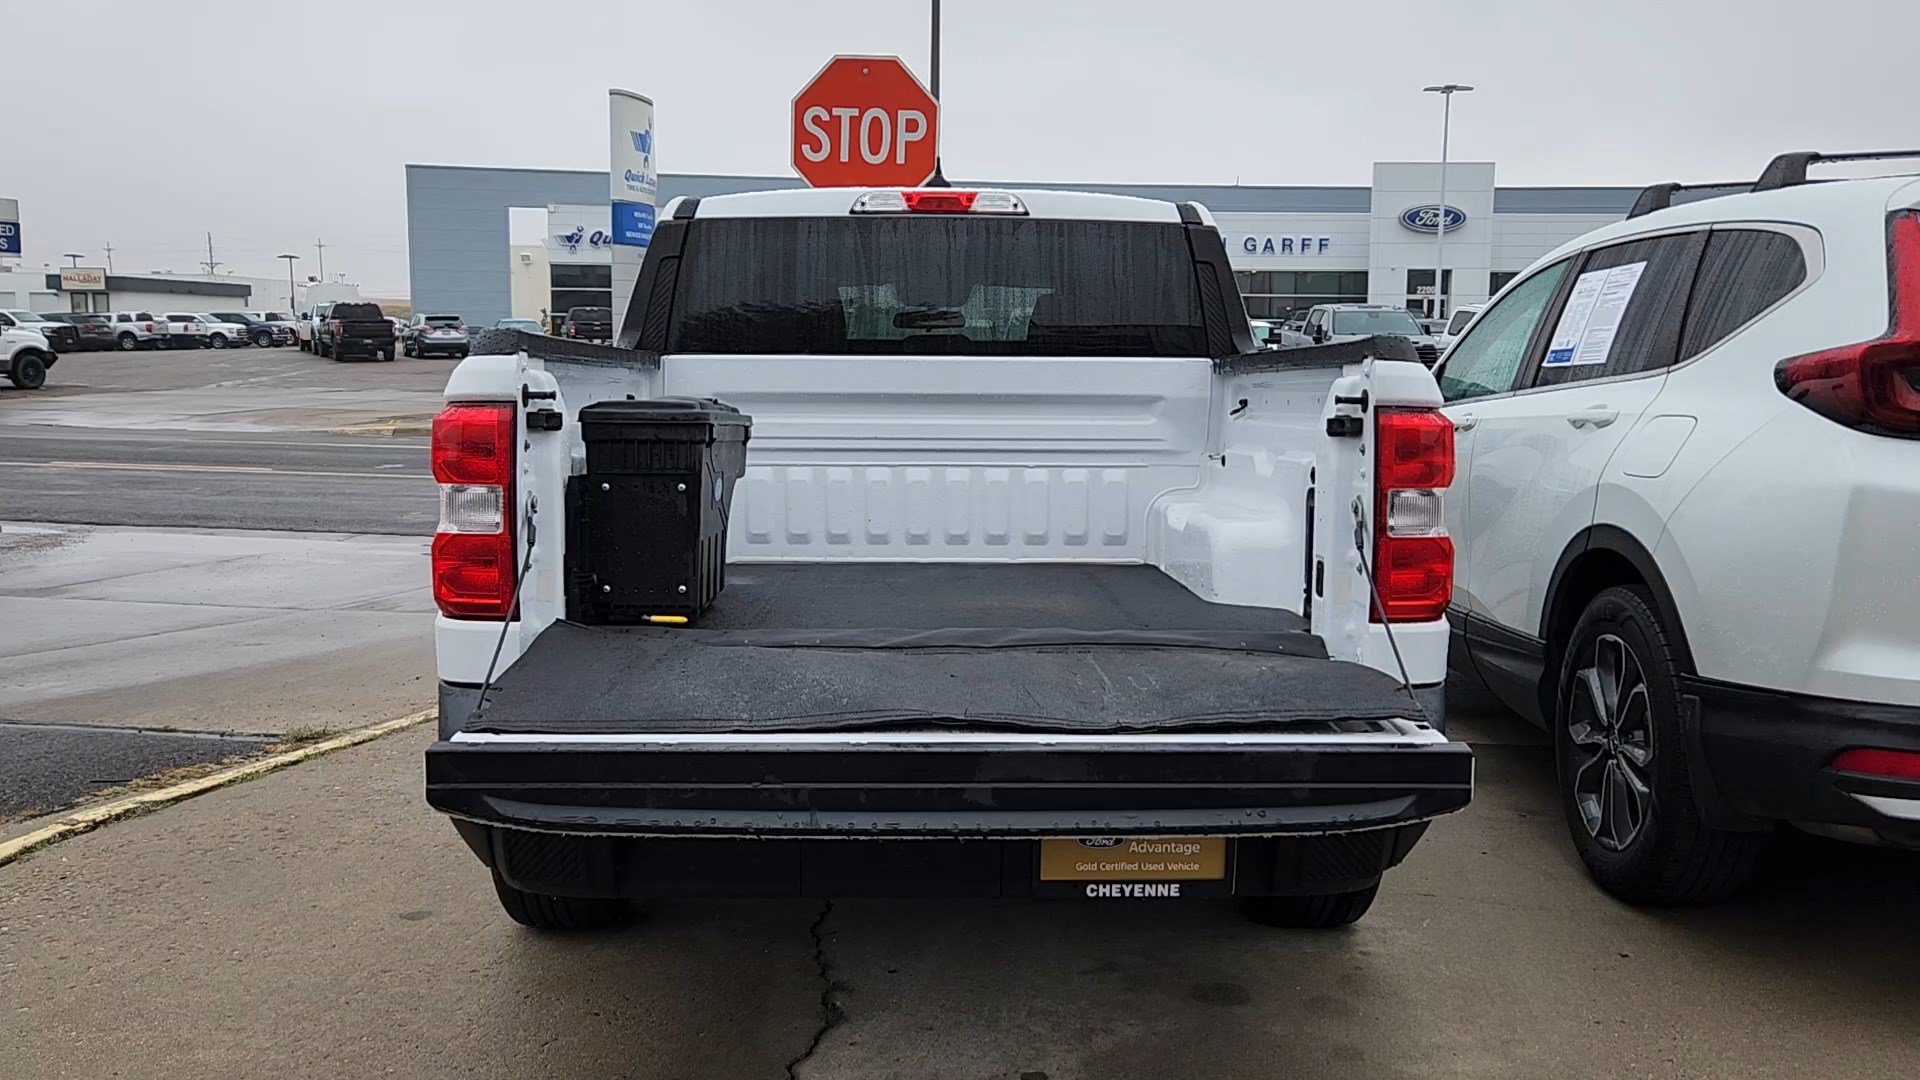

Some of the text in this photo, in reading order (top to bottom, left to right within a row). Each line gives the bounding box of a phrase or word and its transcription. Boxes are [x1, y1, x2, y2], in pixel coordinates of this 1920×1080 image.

[801, 106, 928, 165] STOP
[1244, 237, 1330, 252] GARFF
[62, 275, 102, 283] HALLADAY
[1128, 841, 1201, 855] Advantage
[1075, 861, 1200, 871] Gold Certified Used Vehicle
[1086, 884, 1180, 897] CHEYENNE
